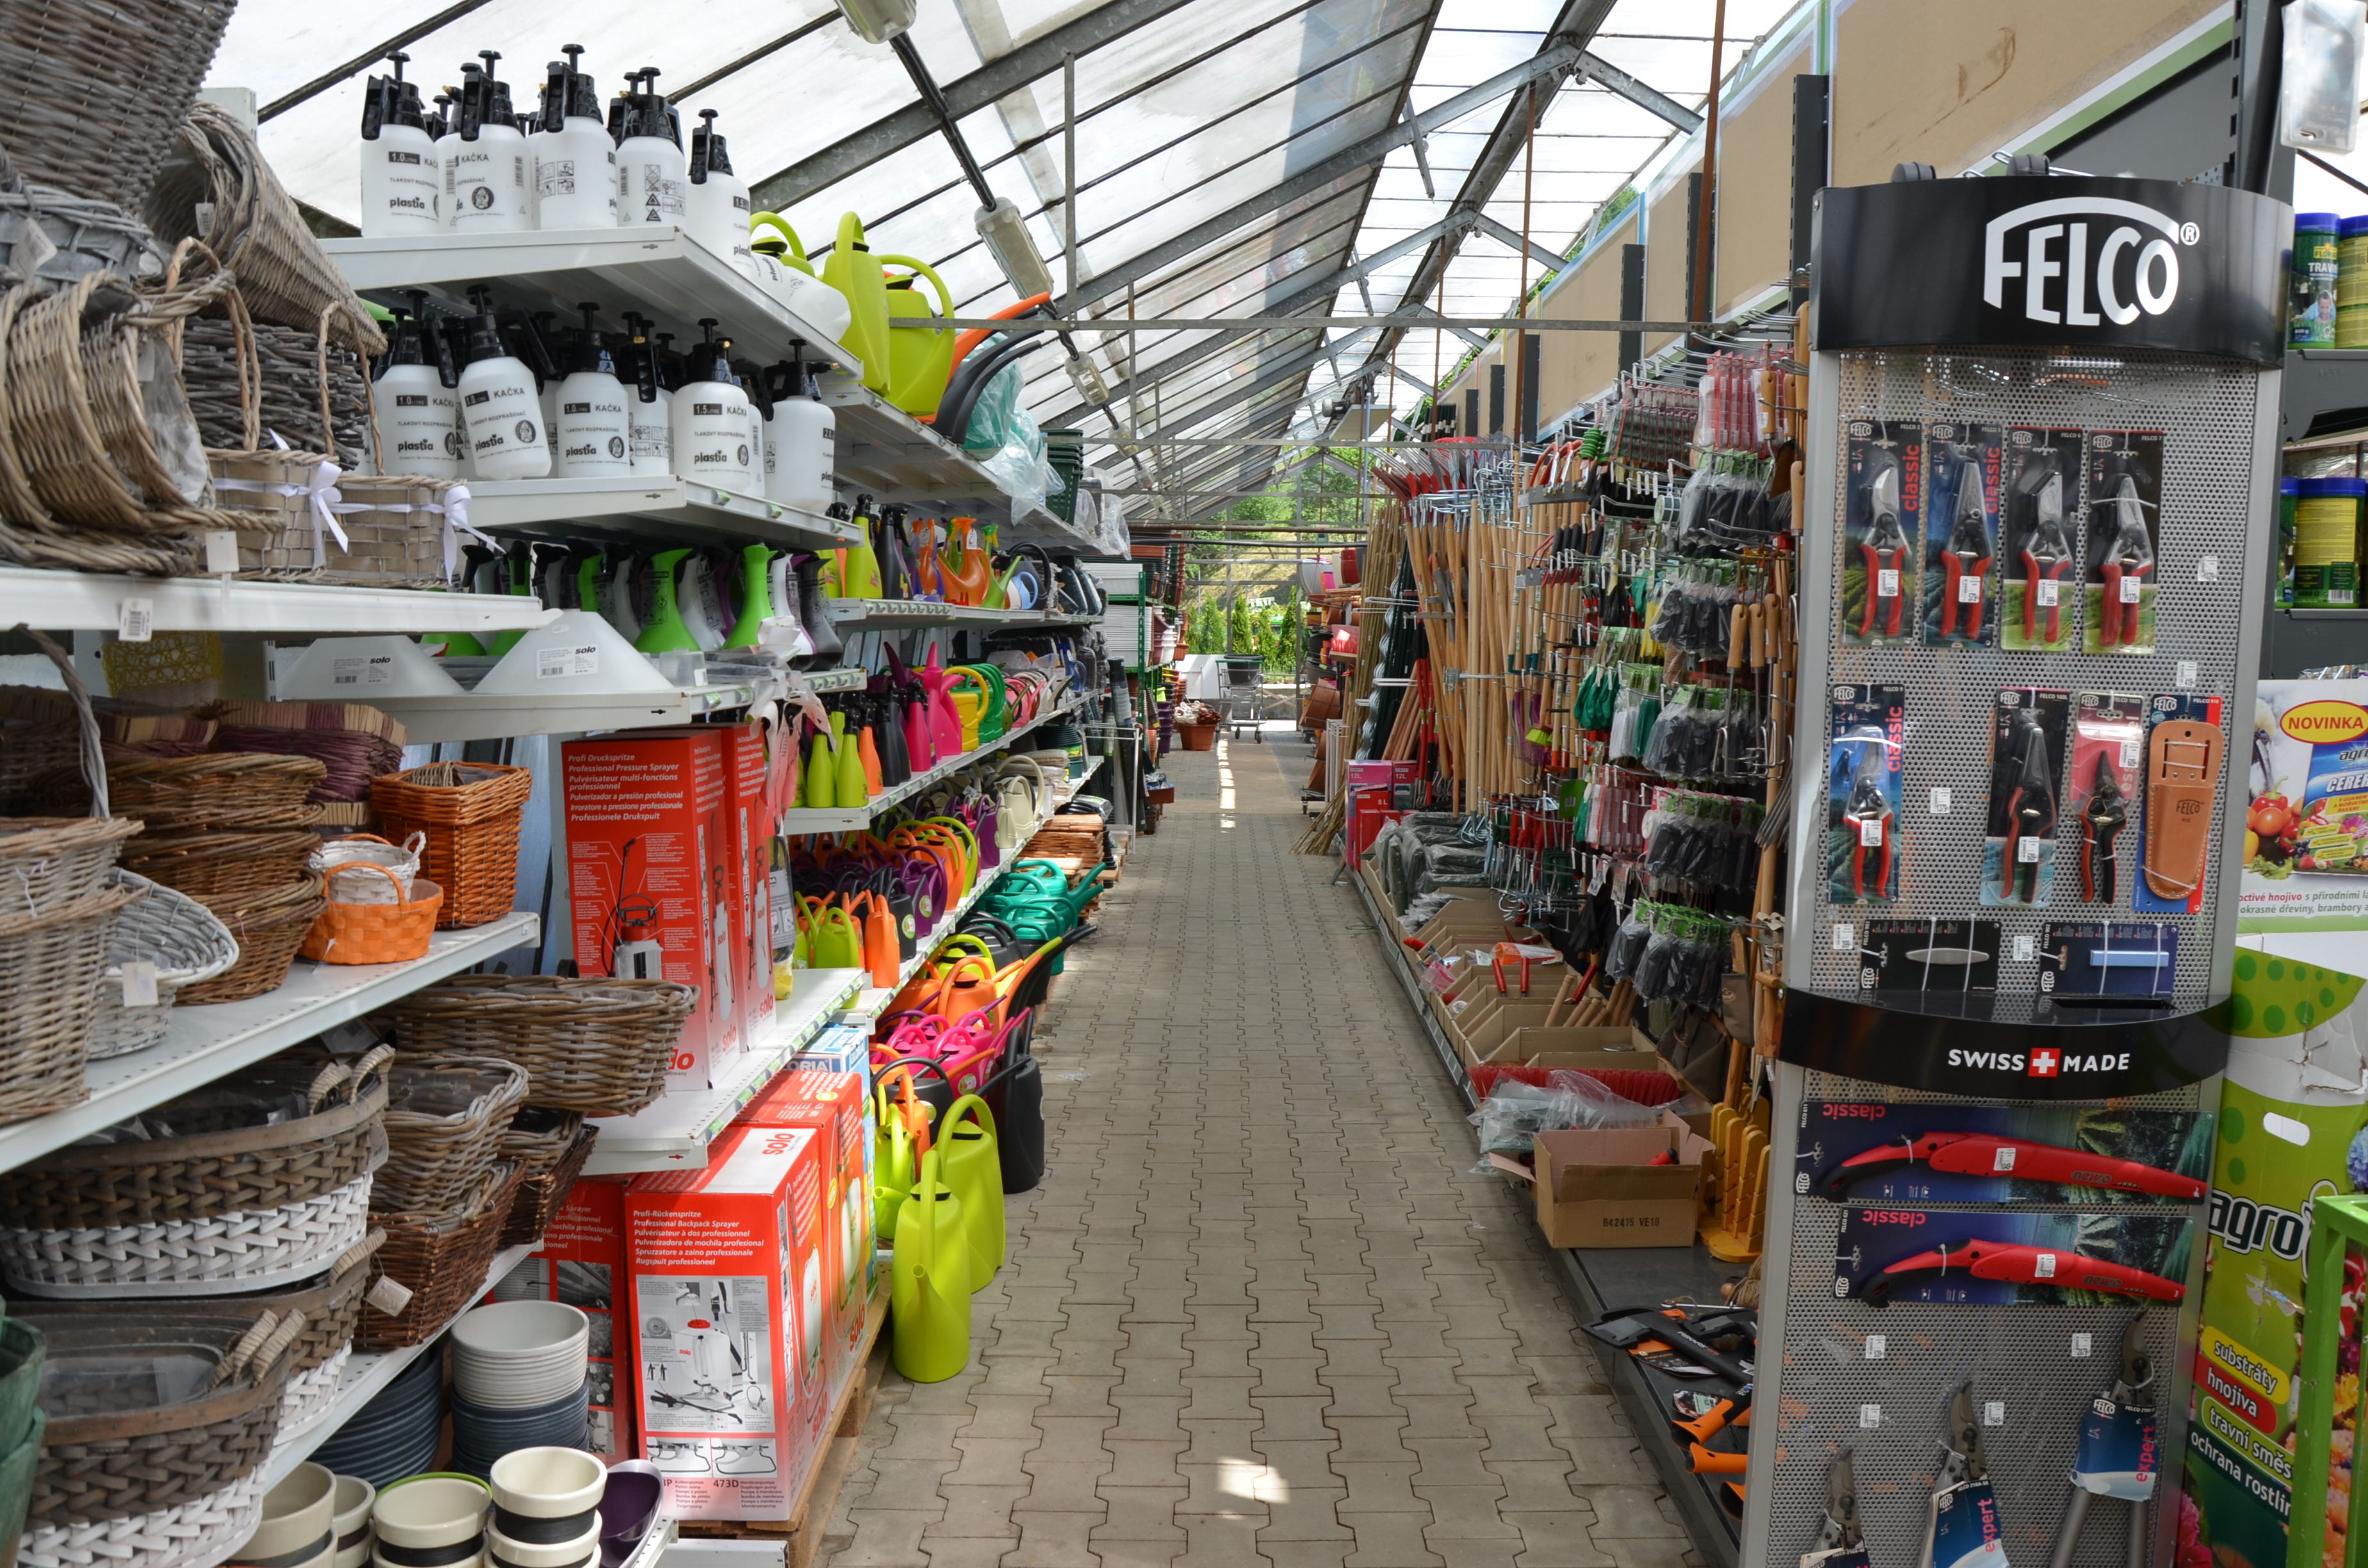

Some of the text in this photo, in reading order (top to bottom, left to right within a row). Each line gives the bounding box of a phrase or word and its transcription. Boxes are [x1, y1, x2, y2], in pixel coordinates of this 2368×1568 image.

[461, 152, 489, 163] KAČKA
[390, 197, 425, 209] plastia
[1984, 197, 2179, 326] FELCO
[493, 386, 525, 398] KAČKA
[595, 403, 621, 413] KAČKA
[1850, 422, 1872, 436] FELCO
[1932, 425, 1953, 439] FELCO
[475, 434, 504, 452] plastia
[2012, 431, 2032, 444] FELCO
[2093, 435, 2113, 448] FELCO
[398, 439, 434, 452] plastia
[566, 444, 596, 458] plastia
[694, 450, 727, 464] plastia
[1902, 445, 1920, 511] classic
[1984, 447, 2000, 513] classic
[575, 646, 596, 655] solo
[370, 657, 390, 665] solo
[1834, 685, 1855, 700] FELCO
[2000, 692, 2020, 705] FELCO
[2081, 695, 2100, 706] FELCO
[2153, 696, 2178, 712] FELCO
[2288, 716, 2364, 730] NOVINKA
[1884, 706, 1903, 772] classic
[588, 753, 635, 762] Druckspritze
[650, 764, 679, 772] Sprayer
[620, 774, 678, 782] multi-fonctions
[570, 782, 621, 792] professionnel
[619, 792, 643, 801] presión
[645, 791, 683, 801] profesional
[608, 803, 638, 812] pressione
[640, 801, 683, 811] professionale
[2176, 799, 2202, 815] FELCO
[571, 812, 660, 821] Professionele Drukspuit
[2269, 892, 2302, 902] hnojivo
[2312, 890, 2360, 902] přírodními
[2240, 903, 2362, 915] okrasné dřeviny, brambory
[1861, 968, 1875, 988] FELCO
[2041, 971, 2055, 992] FELCO
[760, 994, 773, 1018] solo
[723, 1024, 736, 1052] solo
[1948, 1049, 2130, 1073] SWISS MADE
[1823, 1104, 1886, 1121] classic
[762, 1132, 795, 1156] solo
[1796, 1173, 1810, 1193] FELCO
[1603, 1218, 1659, 1227] B42475 VE10
[1862, 1210, 1925, 1227] classic
[576, 1224, 613, 1234] profesional
[559, 1233, 603, 1242] professionale
[636, 1257, 666, 1266] Rugspuit
[1835, 1277, 1849, 1297] FELCO
[2214, 1340, 2278, 1395] substráty
[2207, 1366, 2258, 1419] hnojiva
[2093, 1399, 2116, 1414] FELCO
[2209, 1407, 2294, 1480] travní směs
[2135, 1425, 2155, 1482] expert
[2191, 1431, 2242, 1482] ochrana
[713, 1480, 739, 1488] 473D
[1939, 1494, 1953, 1509] FELCO
[1977, 1499, 1998, 1553] expert
